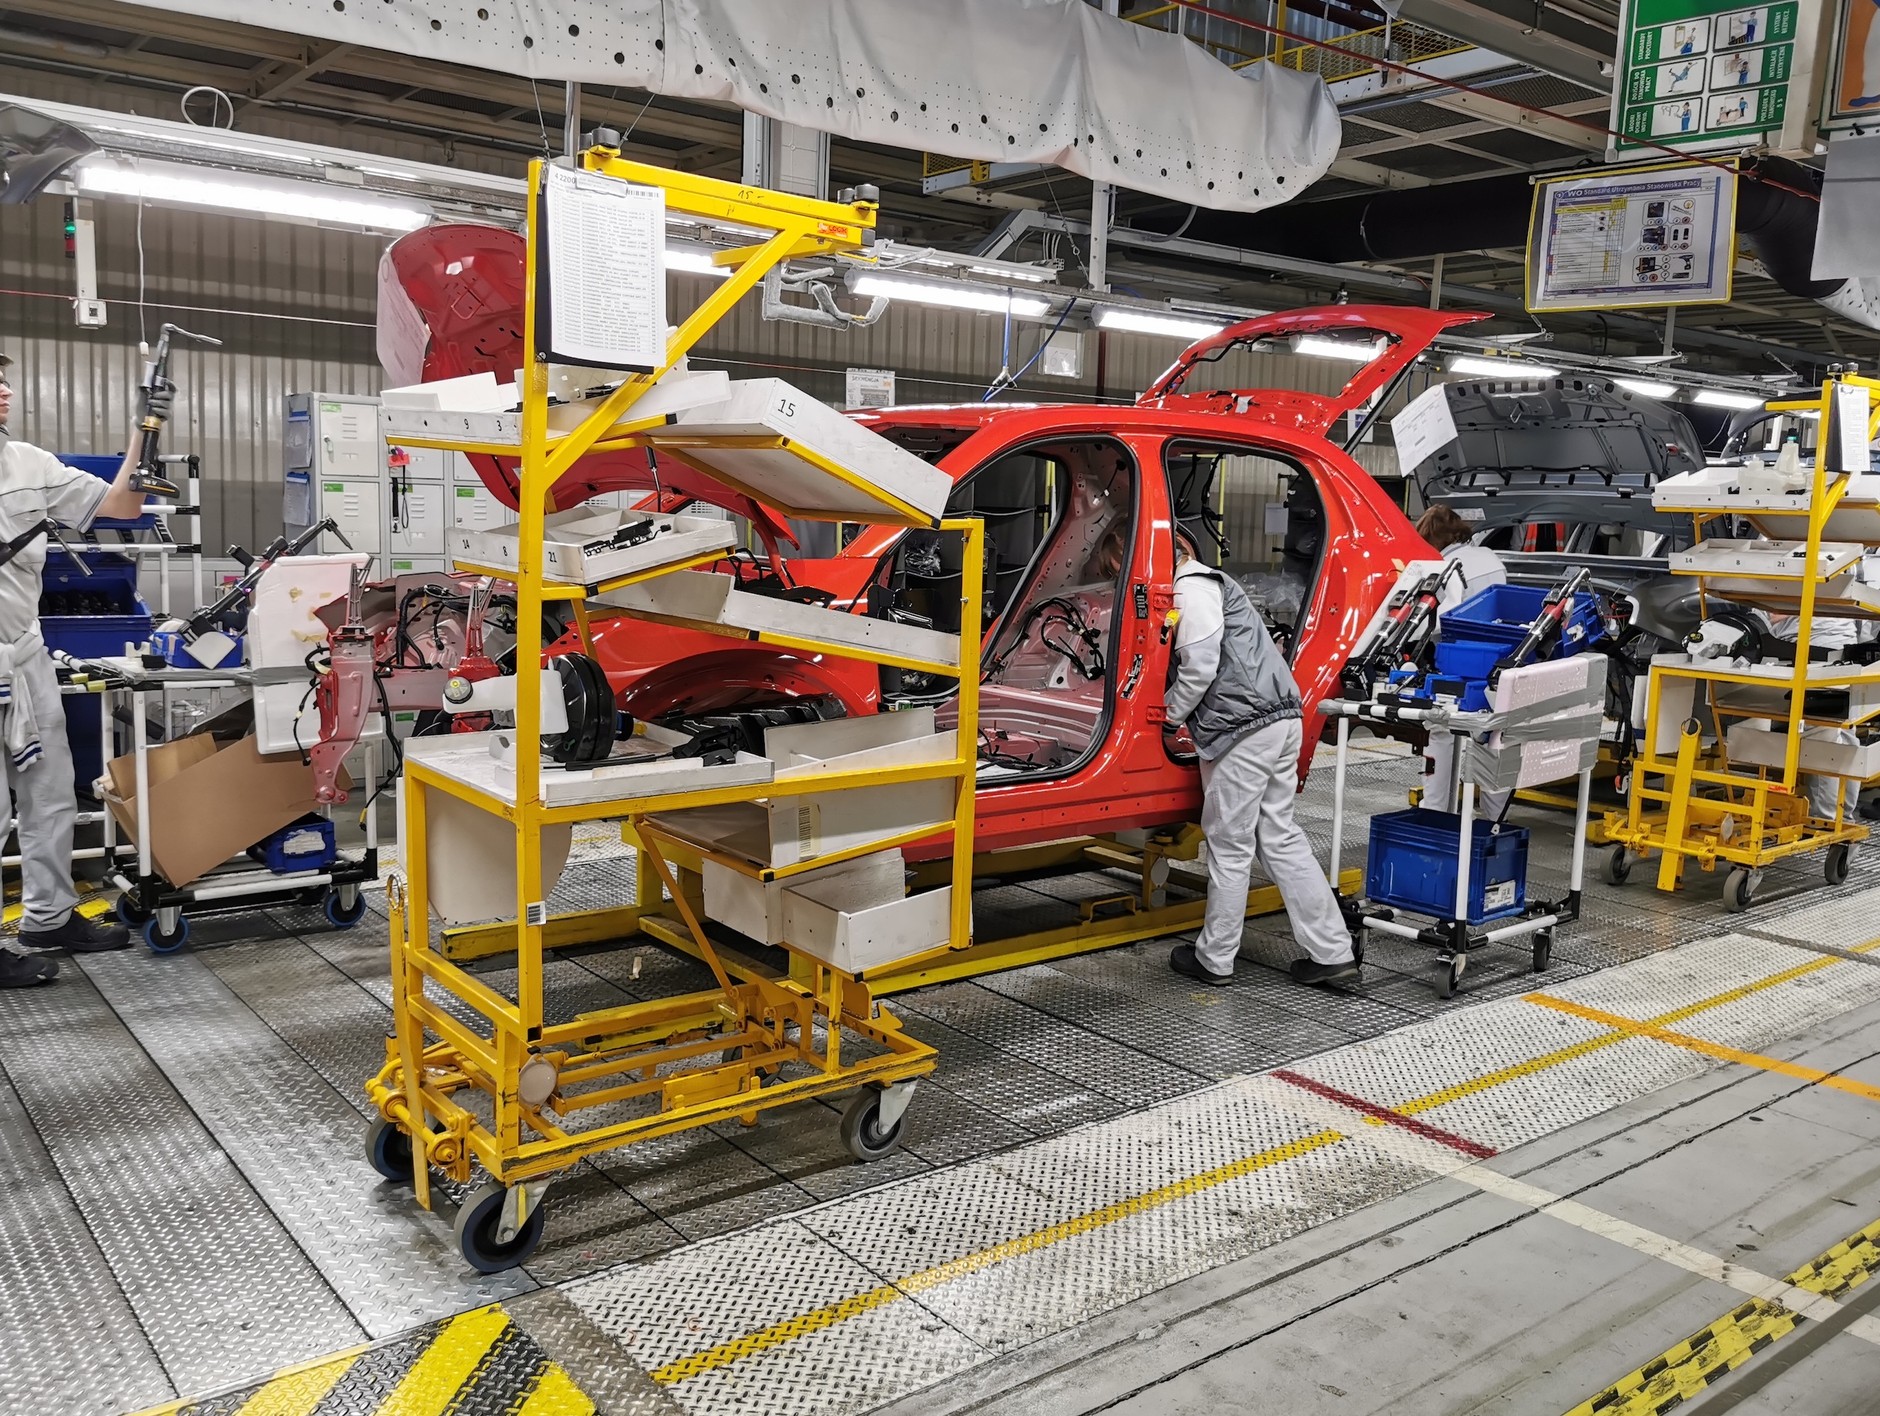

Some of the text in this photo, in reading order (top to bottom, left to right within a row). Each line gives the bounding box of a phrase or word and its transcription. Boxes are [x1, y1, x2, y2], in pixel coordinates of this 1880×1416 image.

[1638, 33, 1646, 60] STANDARDY
[1638, 70, 1646, 100] STANOWISKA
[1612, 186, 1645, 194] Utrzymania
[1647, 182, 1682, 190] Stanowiska
[1683, 181, 1701, 189] Pracy
[778, 399, 796, 417] 15
[464, 419, 502, 431] 9 3
[462, 539, 557, 563] 14 8 21
